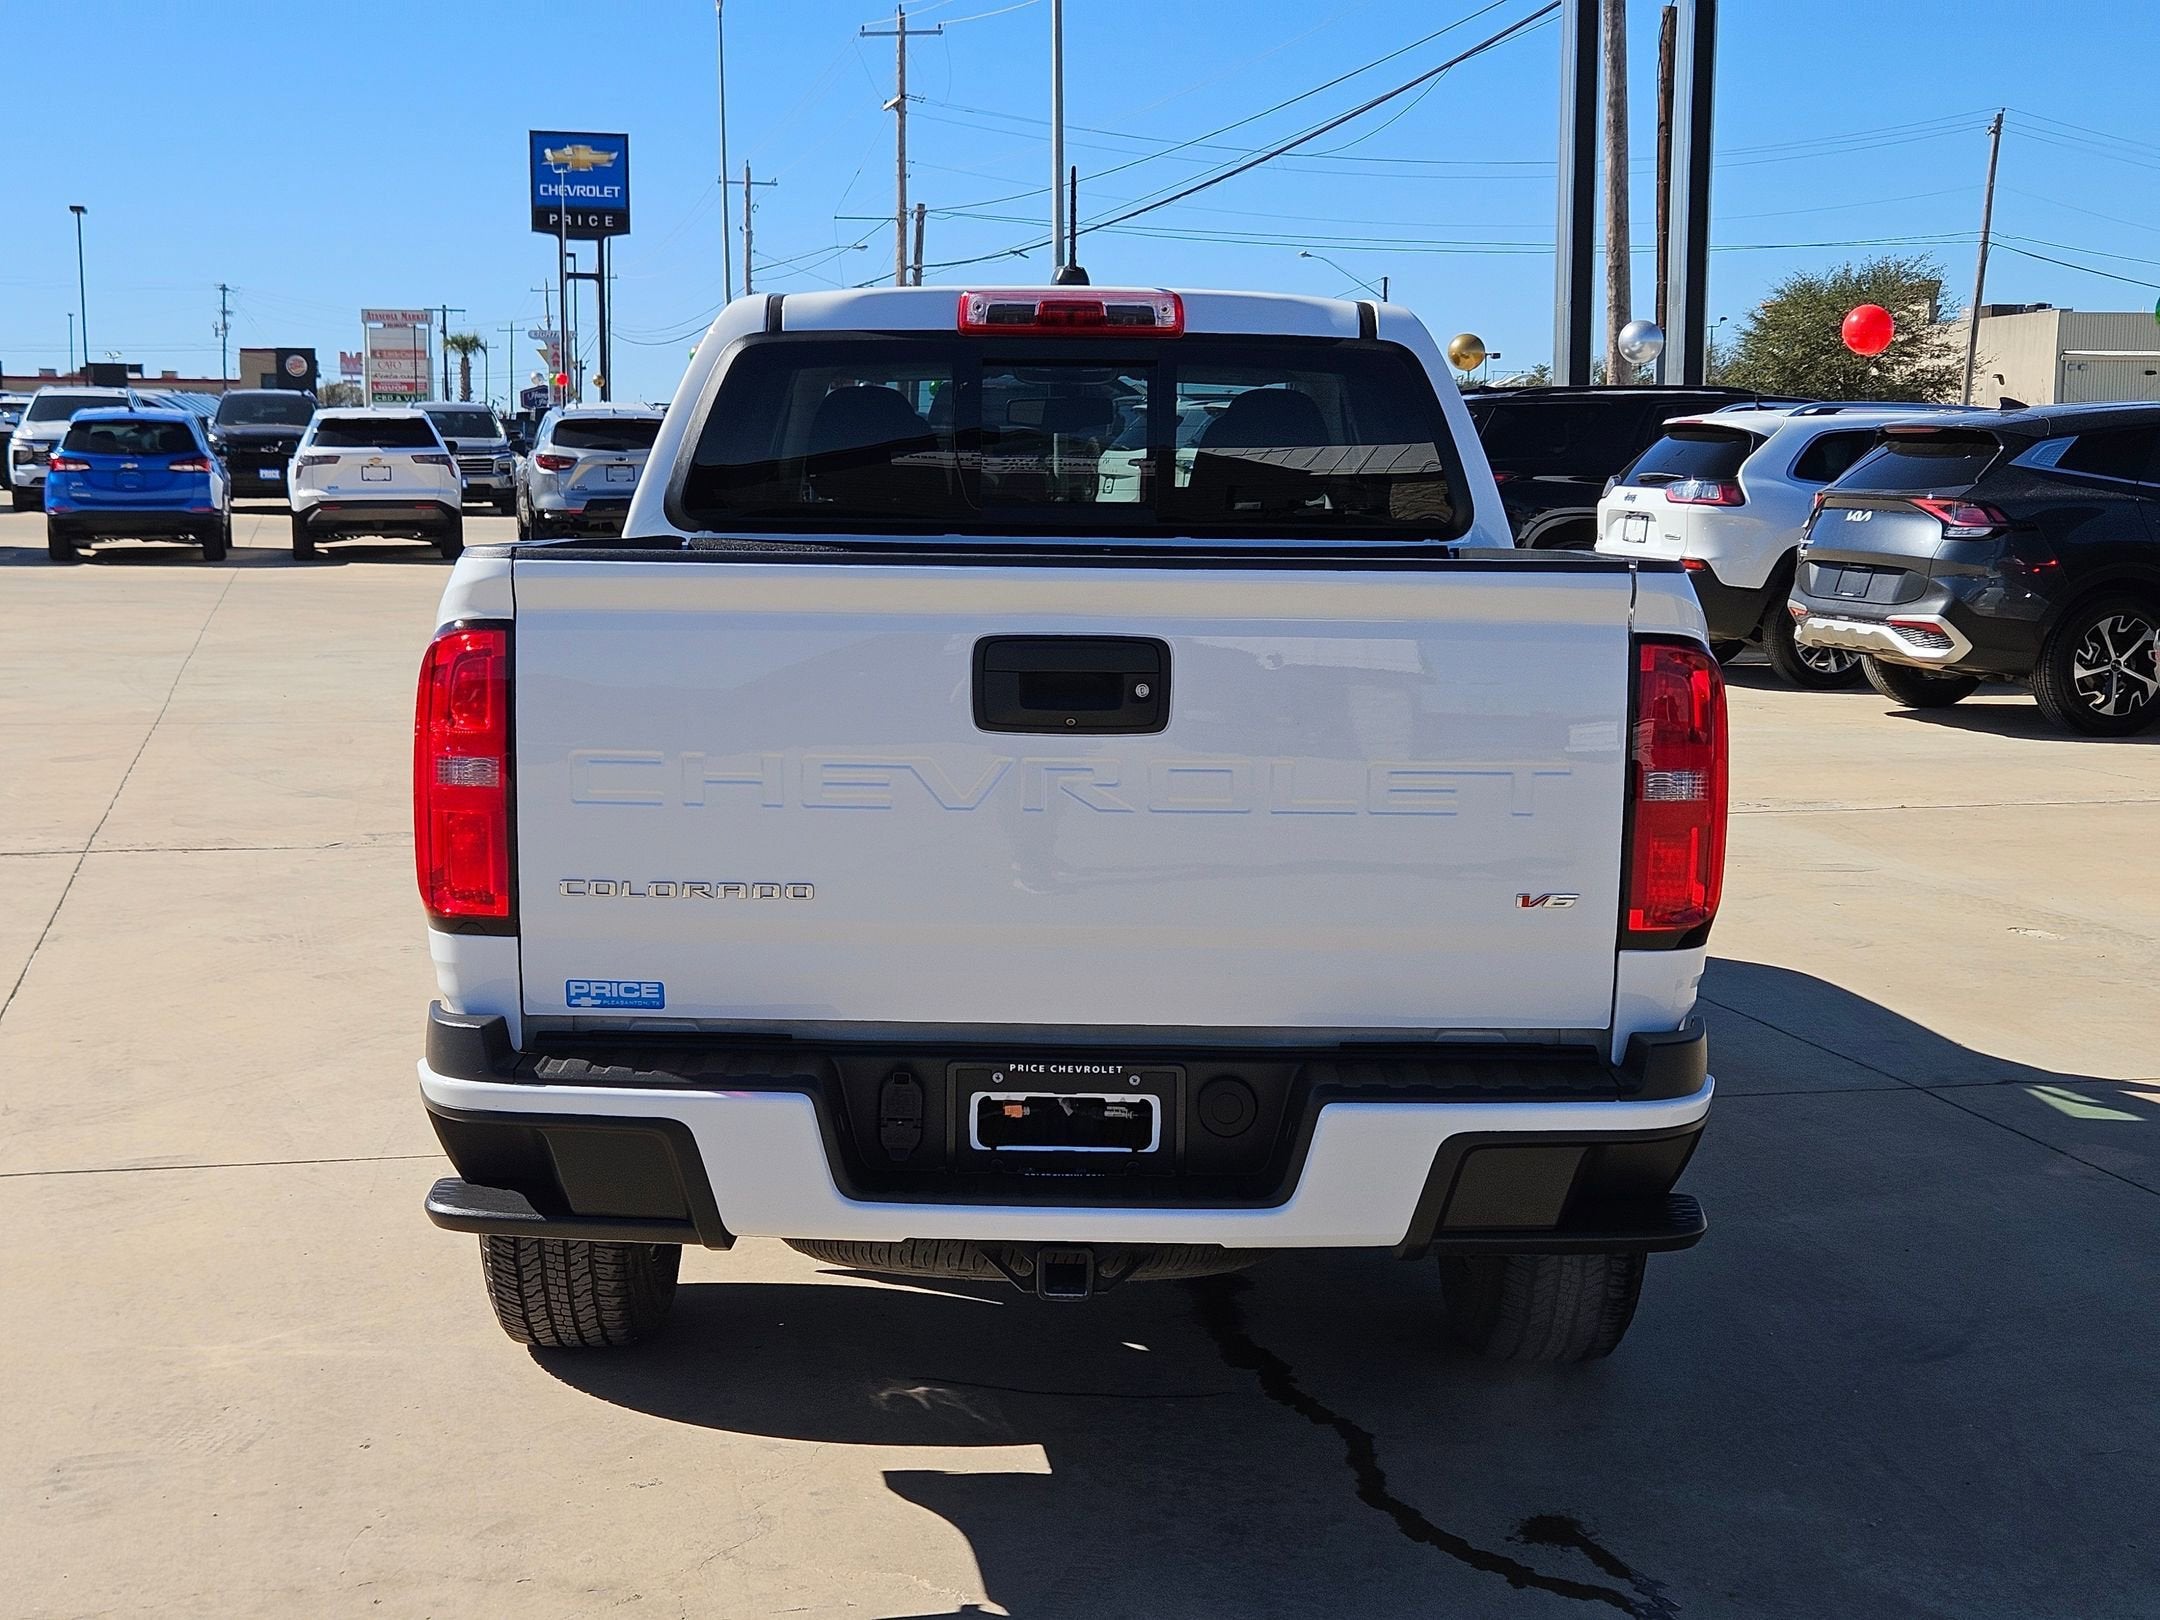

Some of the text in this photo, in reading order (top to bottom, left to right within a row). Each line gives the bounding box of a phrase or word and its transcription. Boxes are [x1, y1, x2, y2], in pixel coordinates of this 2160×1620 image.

[540, 184, 620, 198] CHEVROLET
[549, 213, 614, 227] PRICE
[568, 750, 1571, 816] CHEVROLET
[559, 879, 815, 900] COLORADO
[1515, 893, 1580, 909] V6
[569, 981, 660, 998] PRICE
[1009, 1063, 1123, 1074] PRICE CHEVROLET
